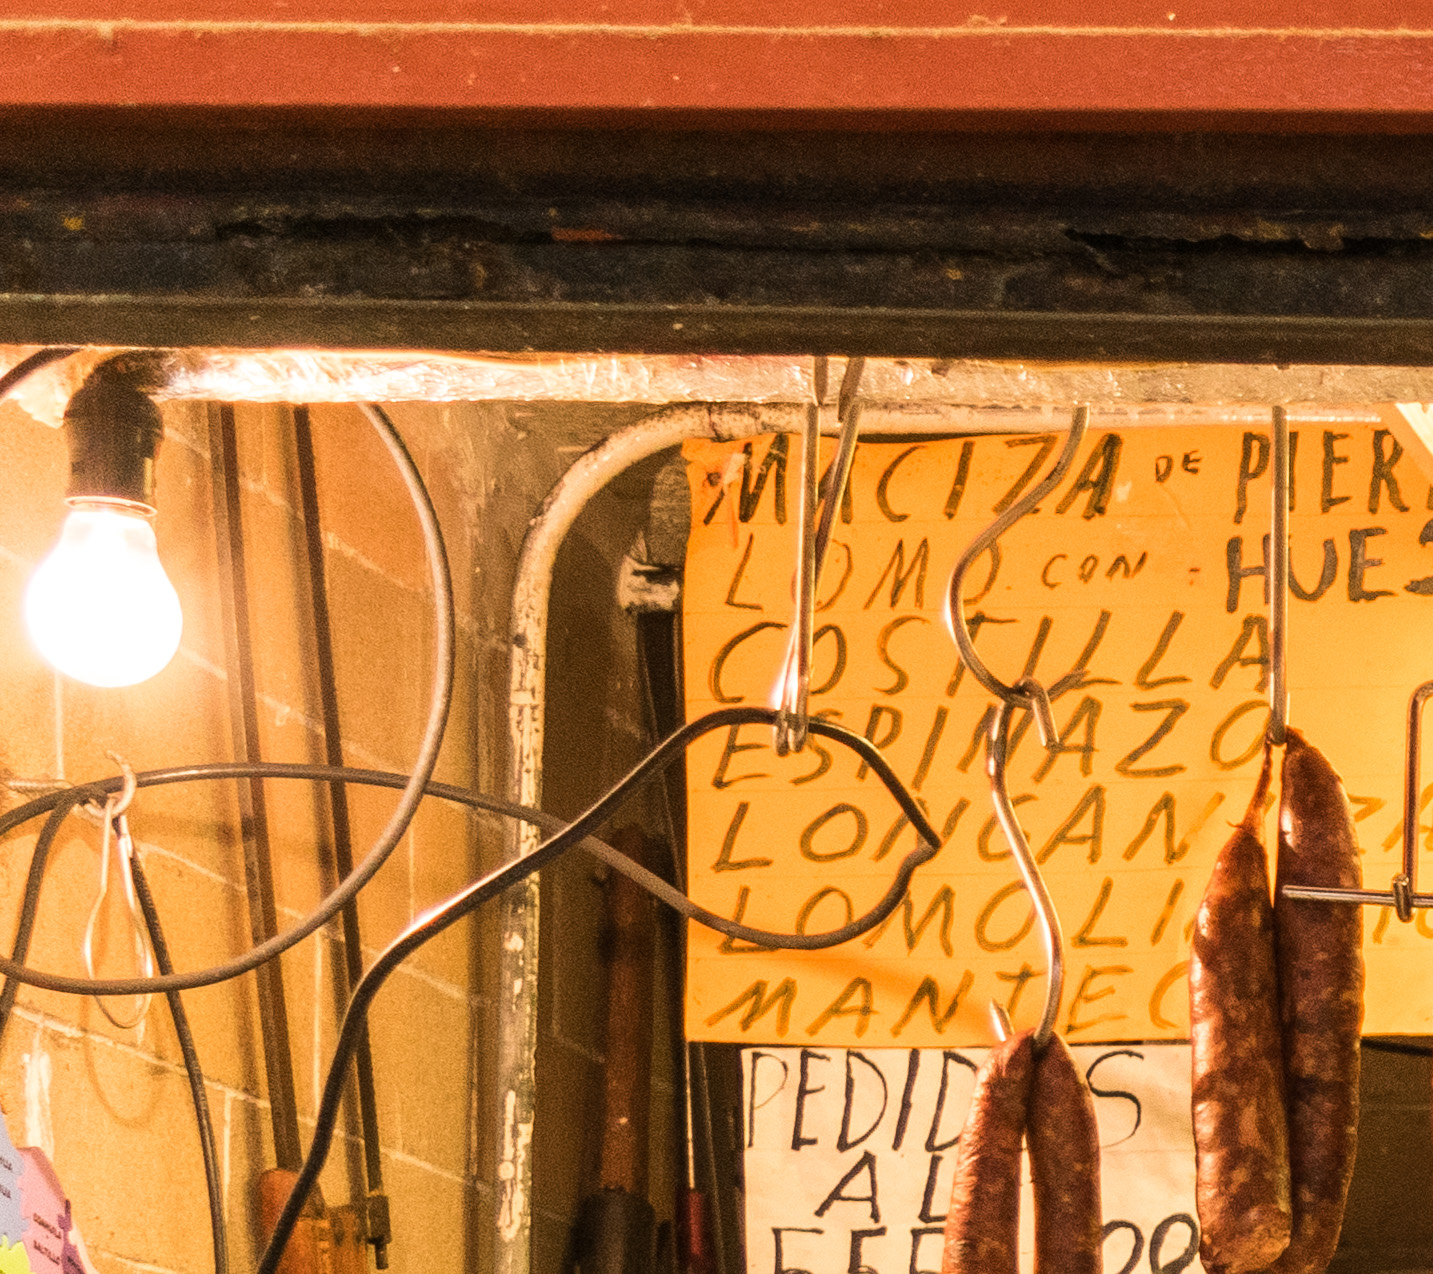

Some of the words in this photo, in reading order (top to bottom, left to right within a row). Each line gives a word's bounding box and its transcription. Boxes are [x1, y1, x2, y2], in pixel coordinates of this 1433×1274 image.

[725, 532, 1002, 610] LOMO
[708, 609, 1271, 705] COSTILLA
[711, 695, 1272, 789] ESPINAZO
[746, 1047, 1146, 1153] PEDIDS
